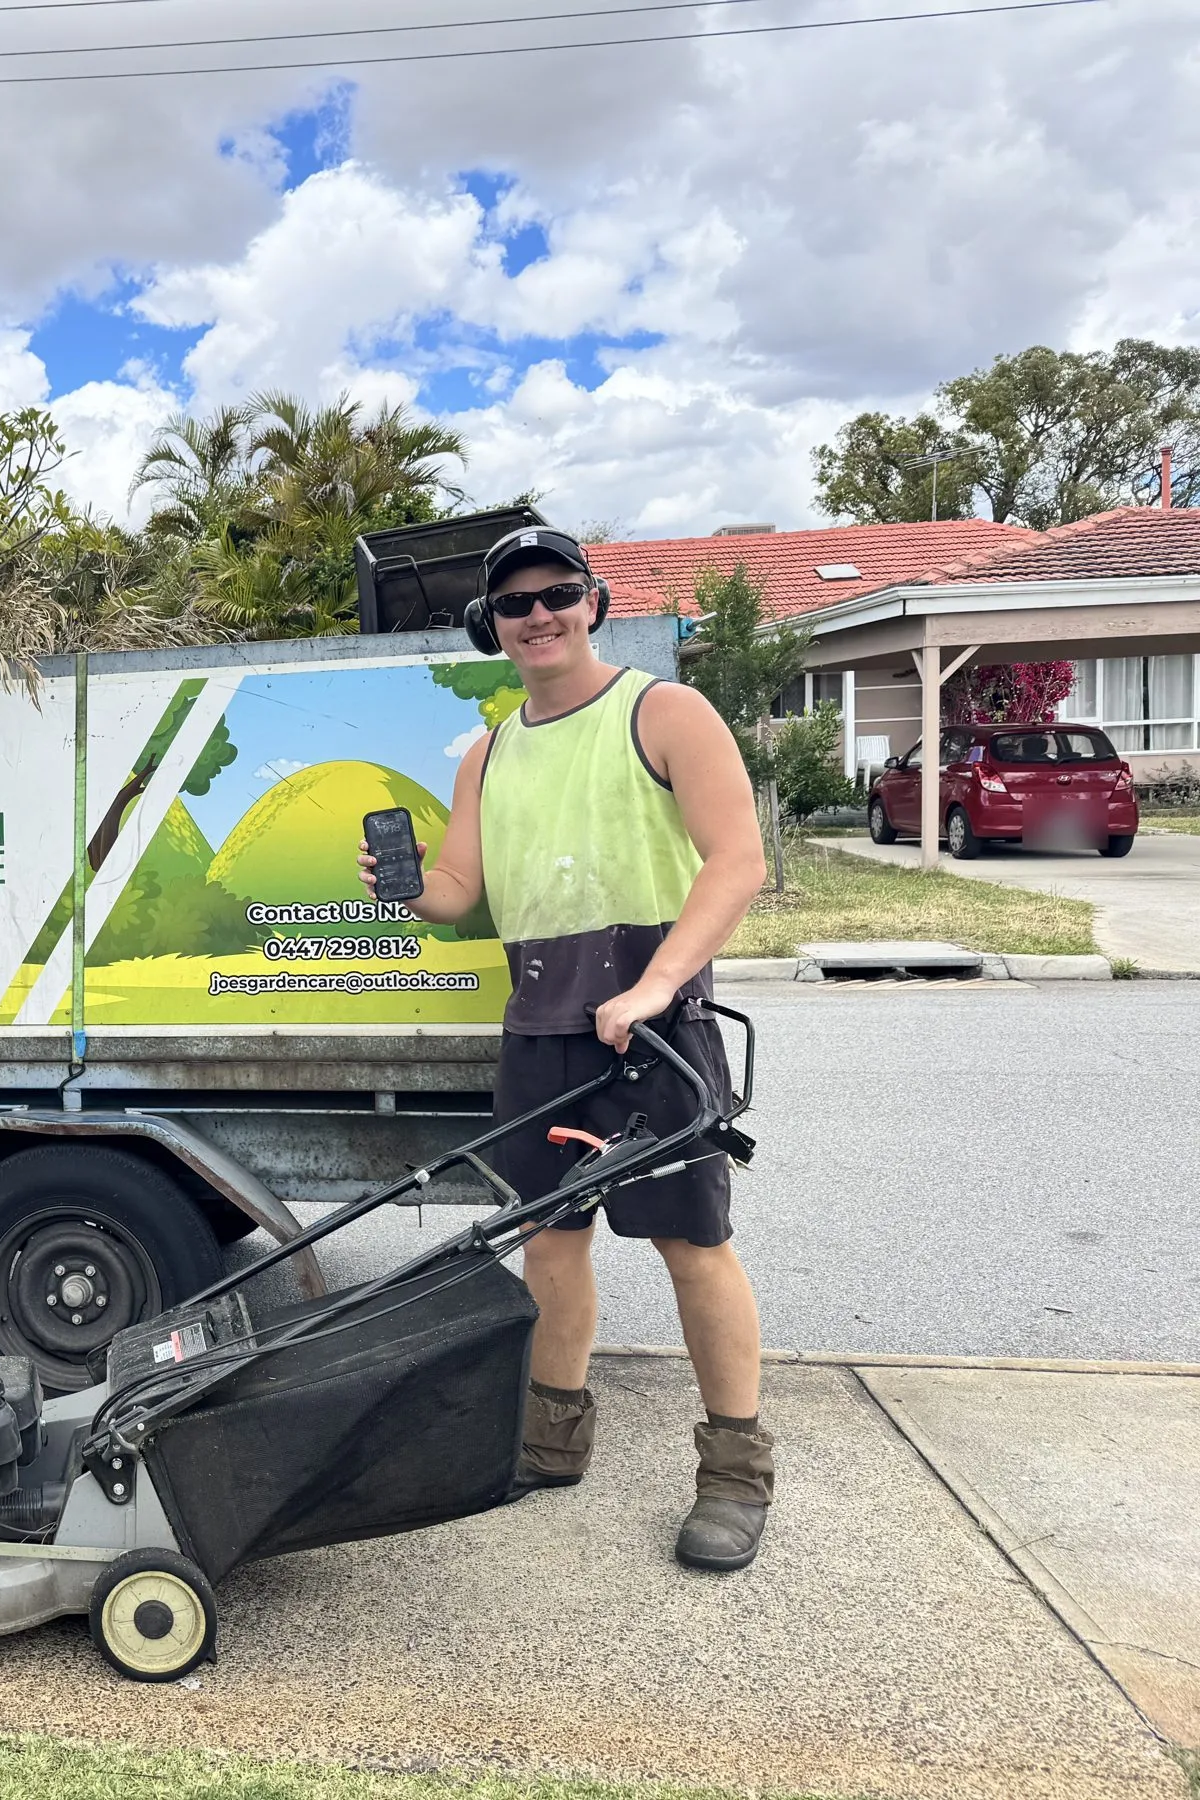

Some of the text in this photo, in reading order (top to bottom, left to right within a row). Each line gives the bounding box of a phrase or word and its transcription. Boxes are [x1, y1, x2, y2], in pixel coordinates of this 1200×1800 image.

[248, 901, 421, 924] Contact Us No
[265, 935, 419, 959] 0447 298 814
[209, 971, 479, 994] joesgardencare@outlook.com
